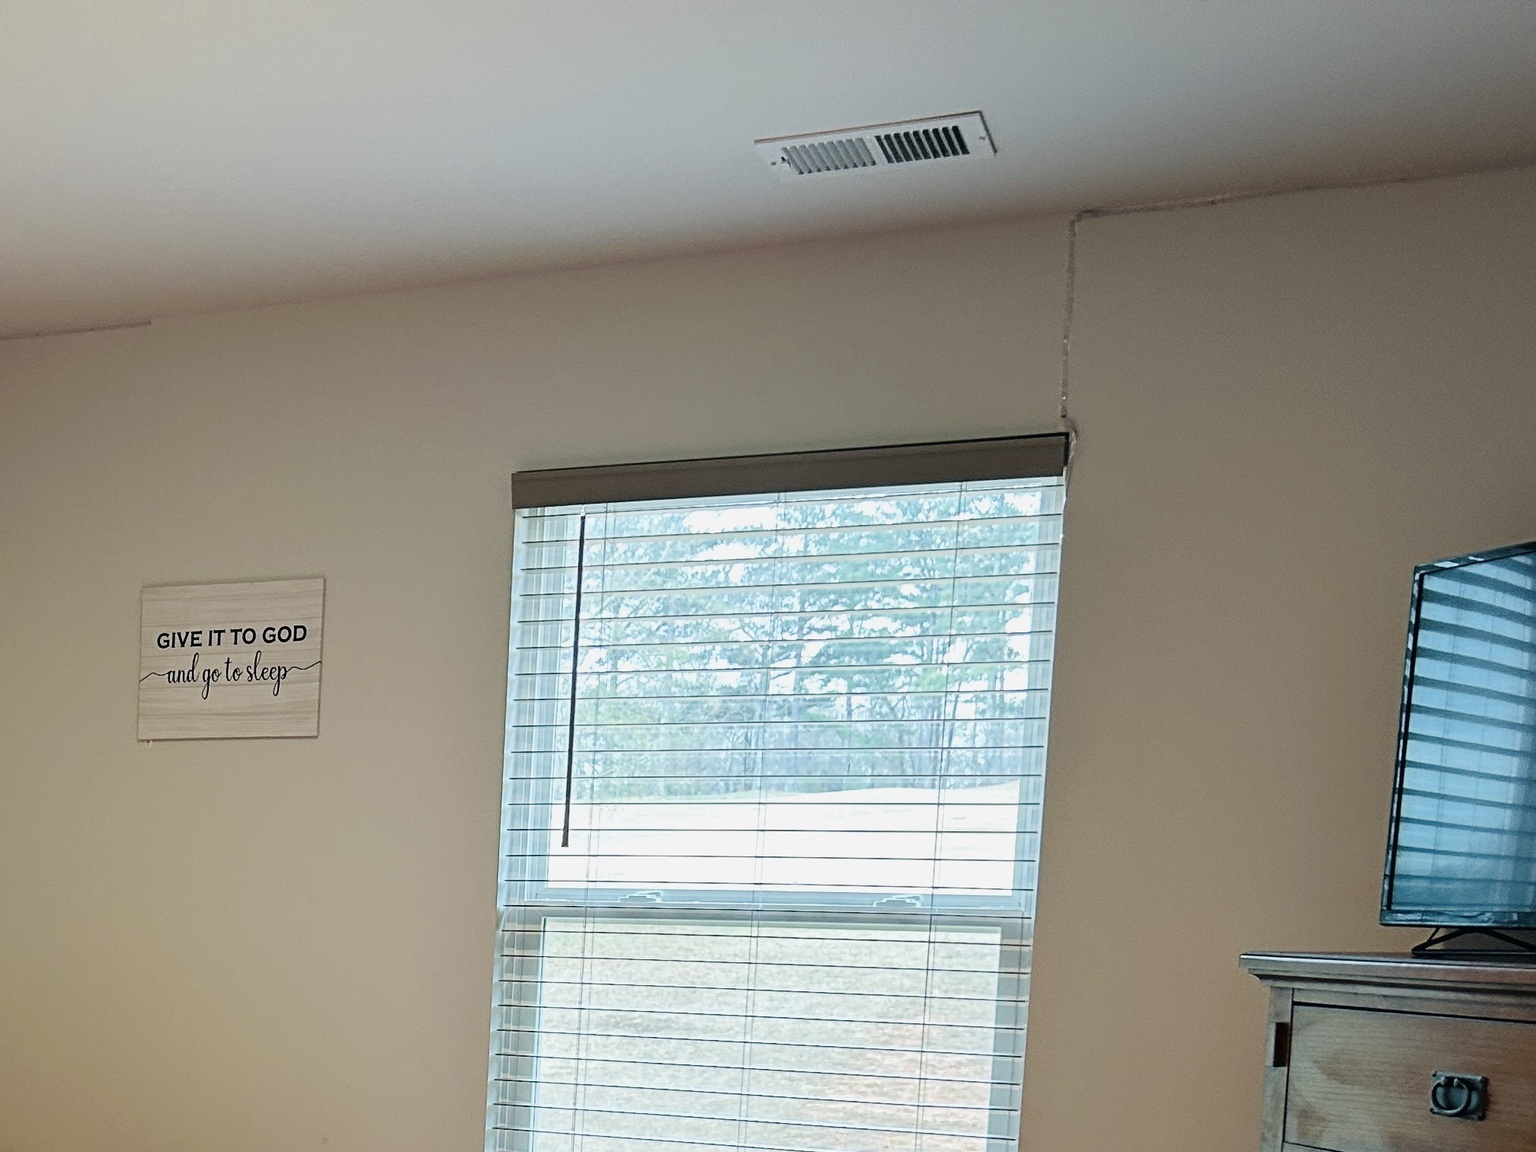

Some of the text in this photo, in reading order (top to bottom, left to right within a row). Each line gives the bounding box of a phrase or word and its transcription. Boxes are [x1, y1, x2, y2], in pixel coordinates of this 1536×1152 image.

[157, 625, 308, 649] GIVE IT TO GOD
[166, 650, 288, 700] and go to sleep
